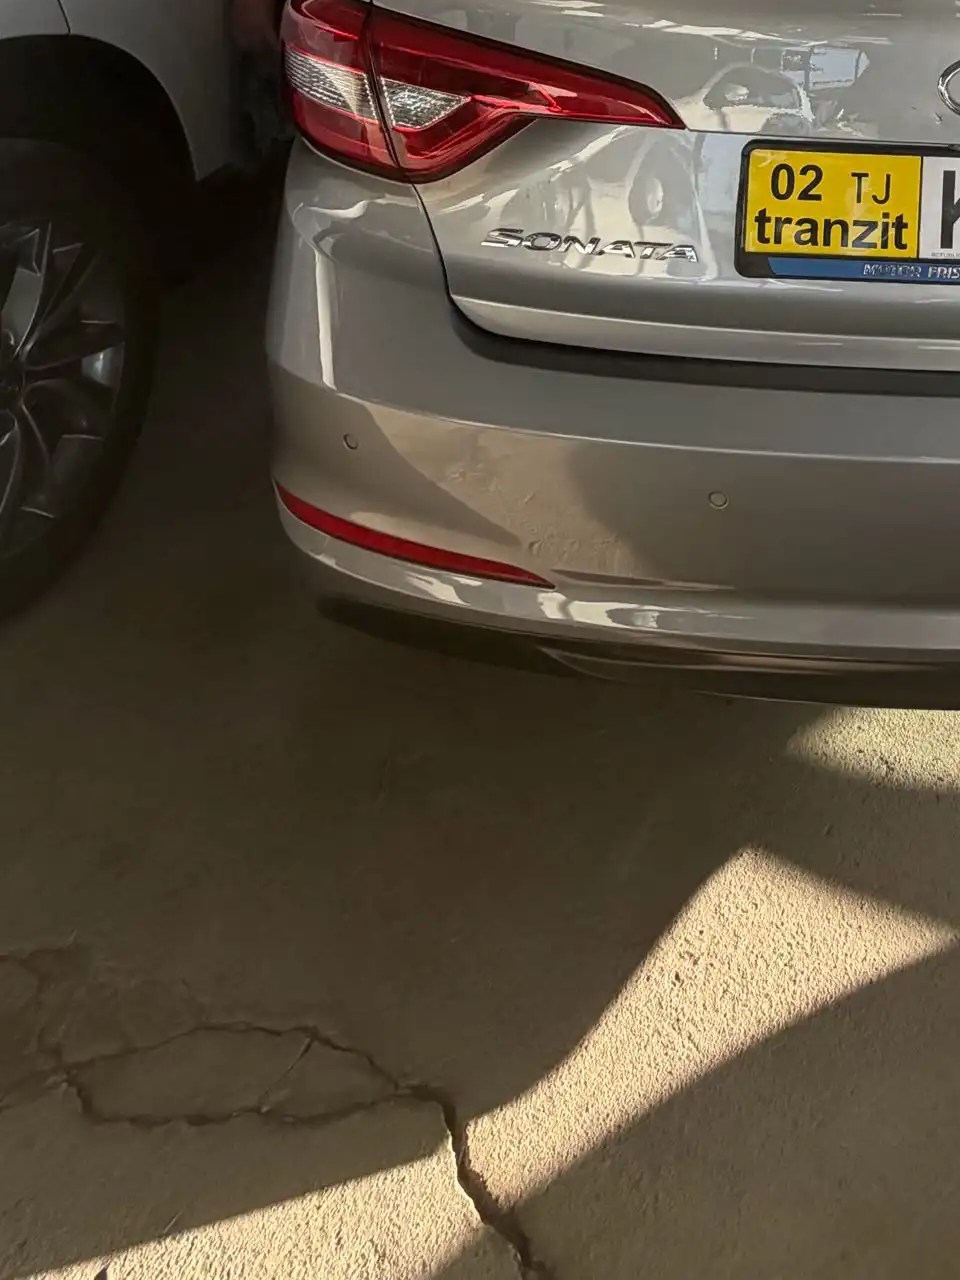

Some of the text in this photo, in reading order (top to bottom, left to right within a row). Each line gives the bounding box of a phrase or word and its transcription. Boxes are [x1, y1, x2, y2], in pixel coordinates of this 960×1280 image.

[770, 163, 892, 205] 02 TJ
[480, 227, 699, 263] SONATA
[754, 208, 909, 251] tranzit
